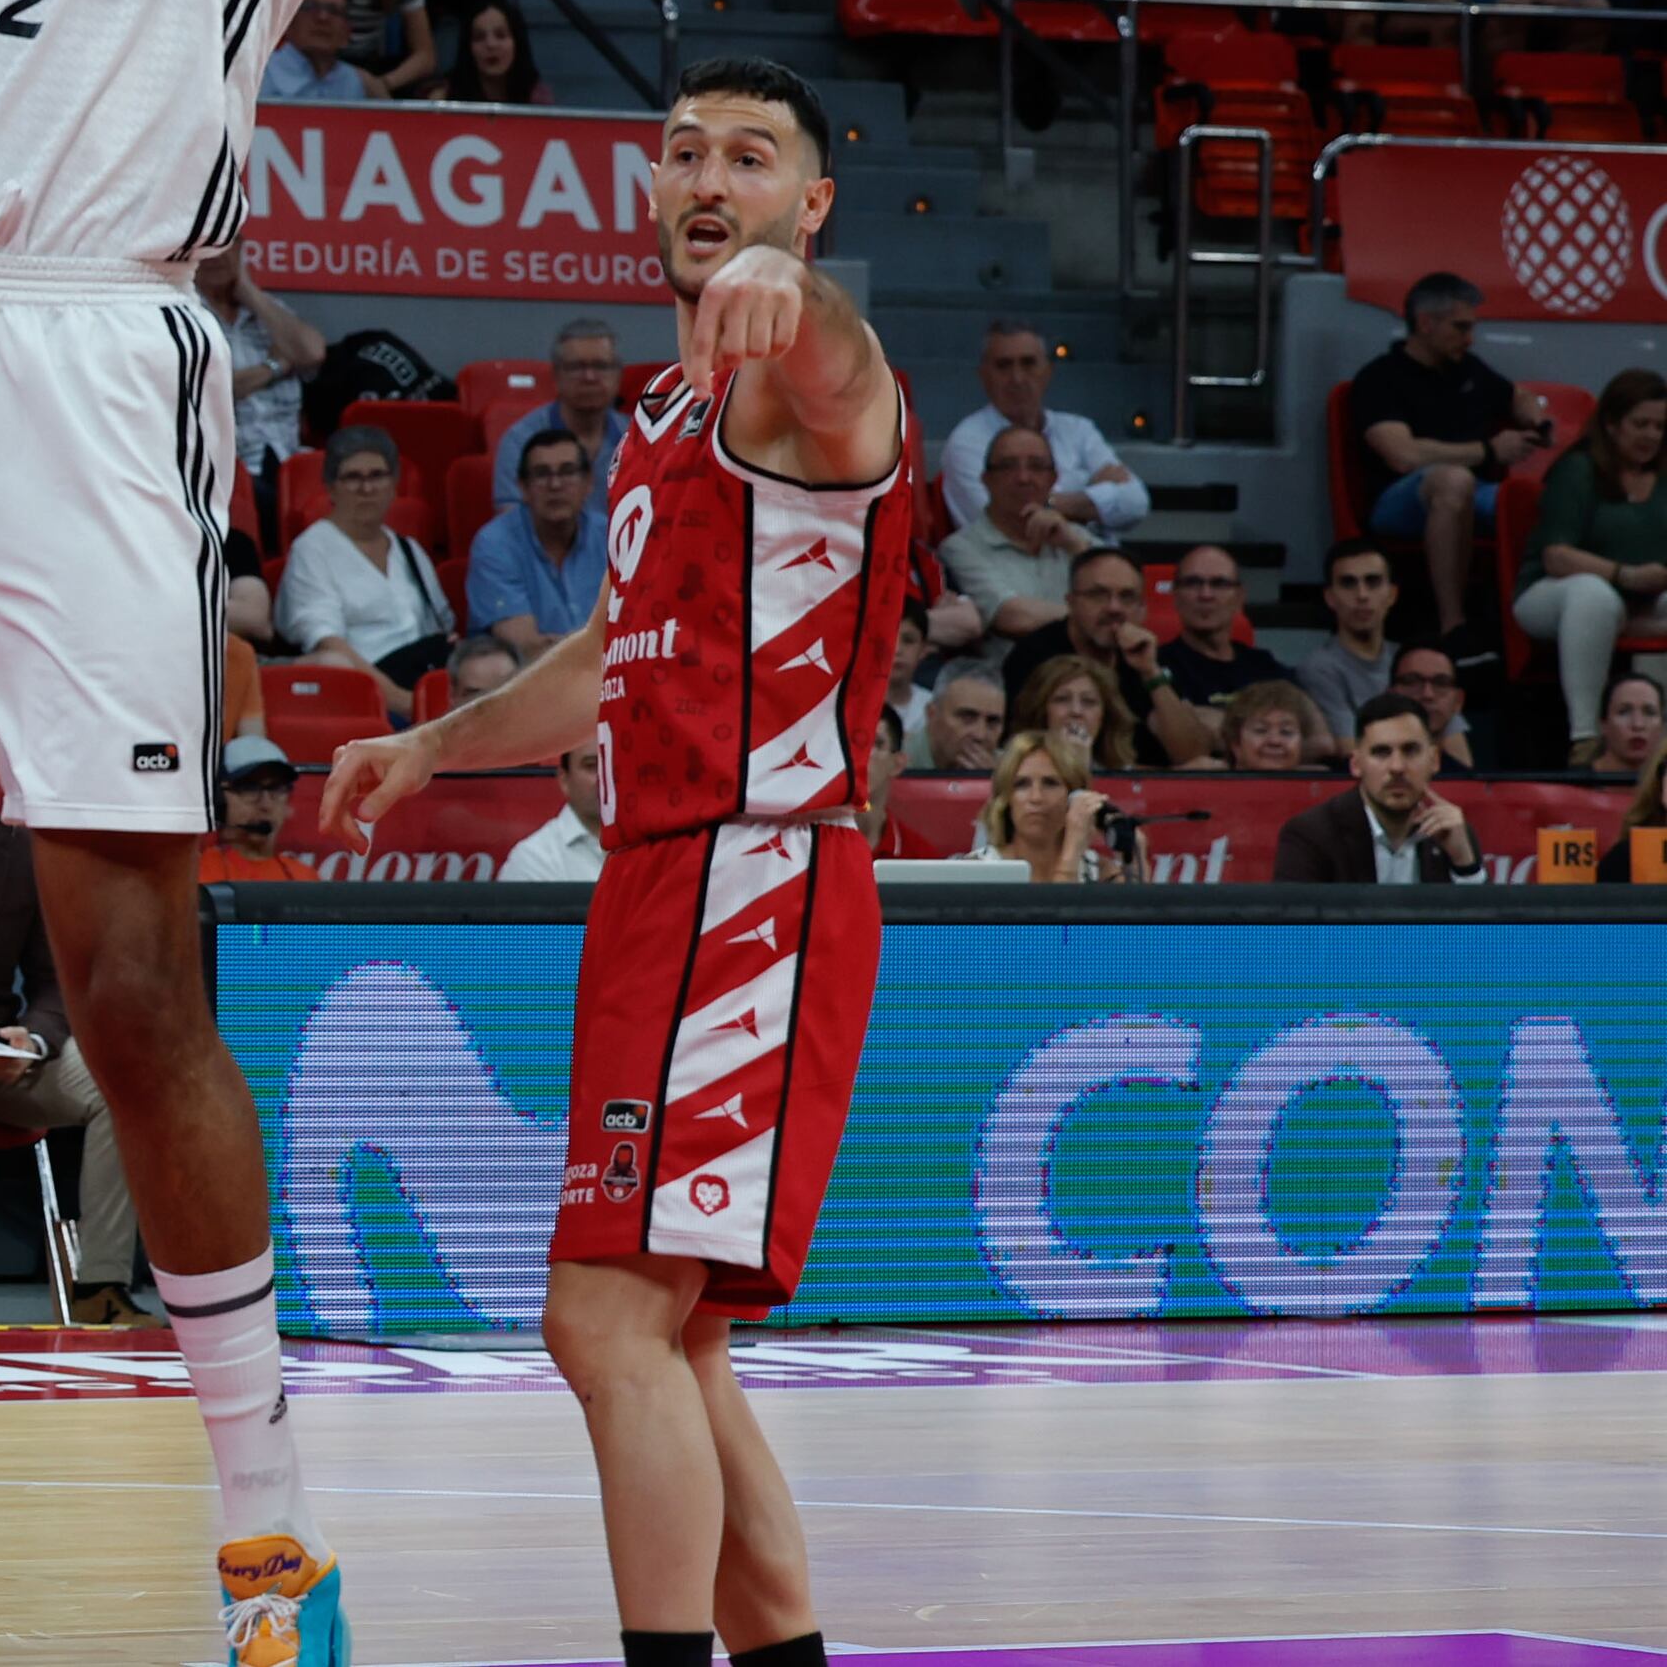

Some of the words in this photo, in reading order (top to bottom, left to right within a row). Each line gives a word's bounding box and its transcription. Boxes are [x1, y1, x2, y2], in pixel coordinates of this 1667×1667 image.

[436, 247, 489, 281] DE
[136, 752, 171, 771] acb
[606, 1113, 638, 1128] acb
